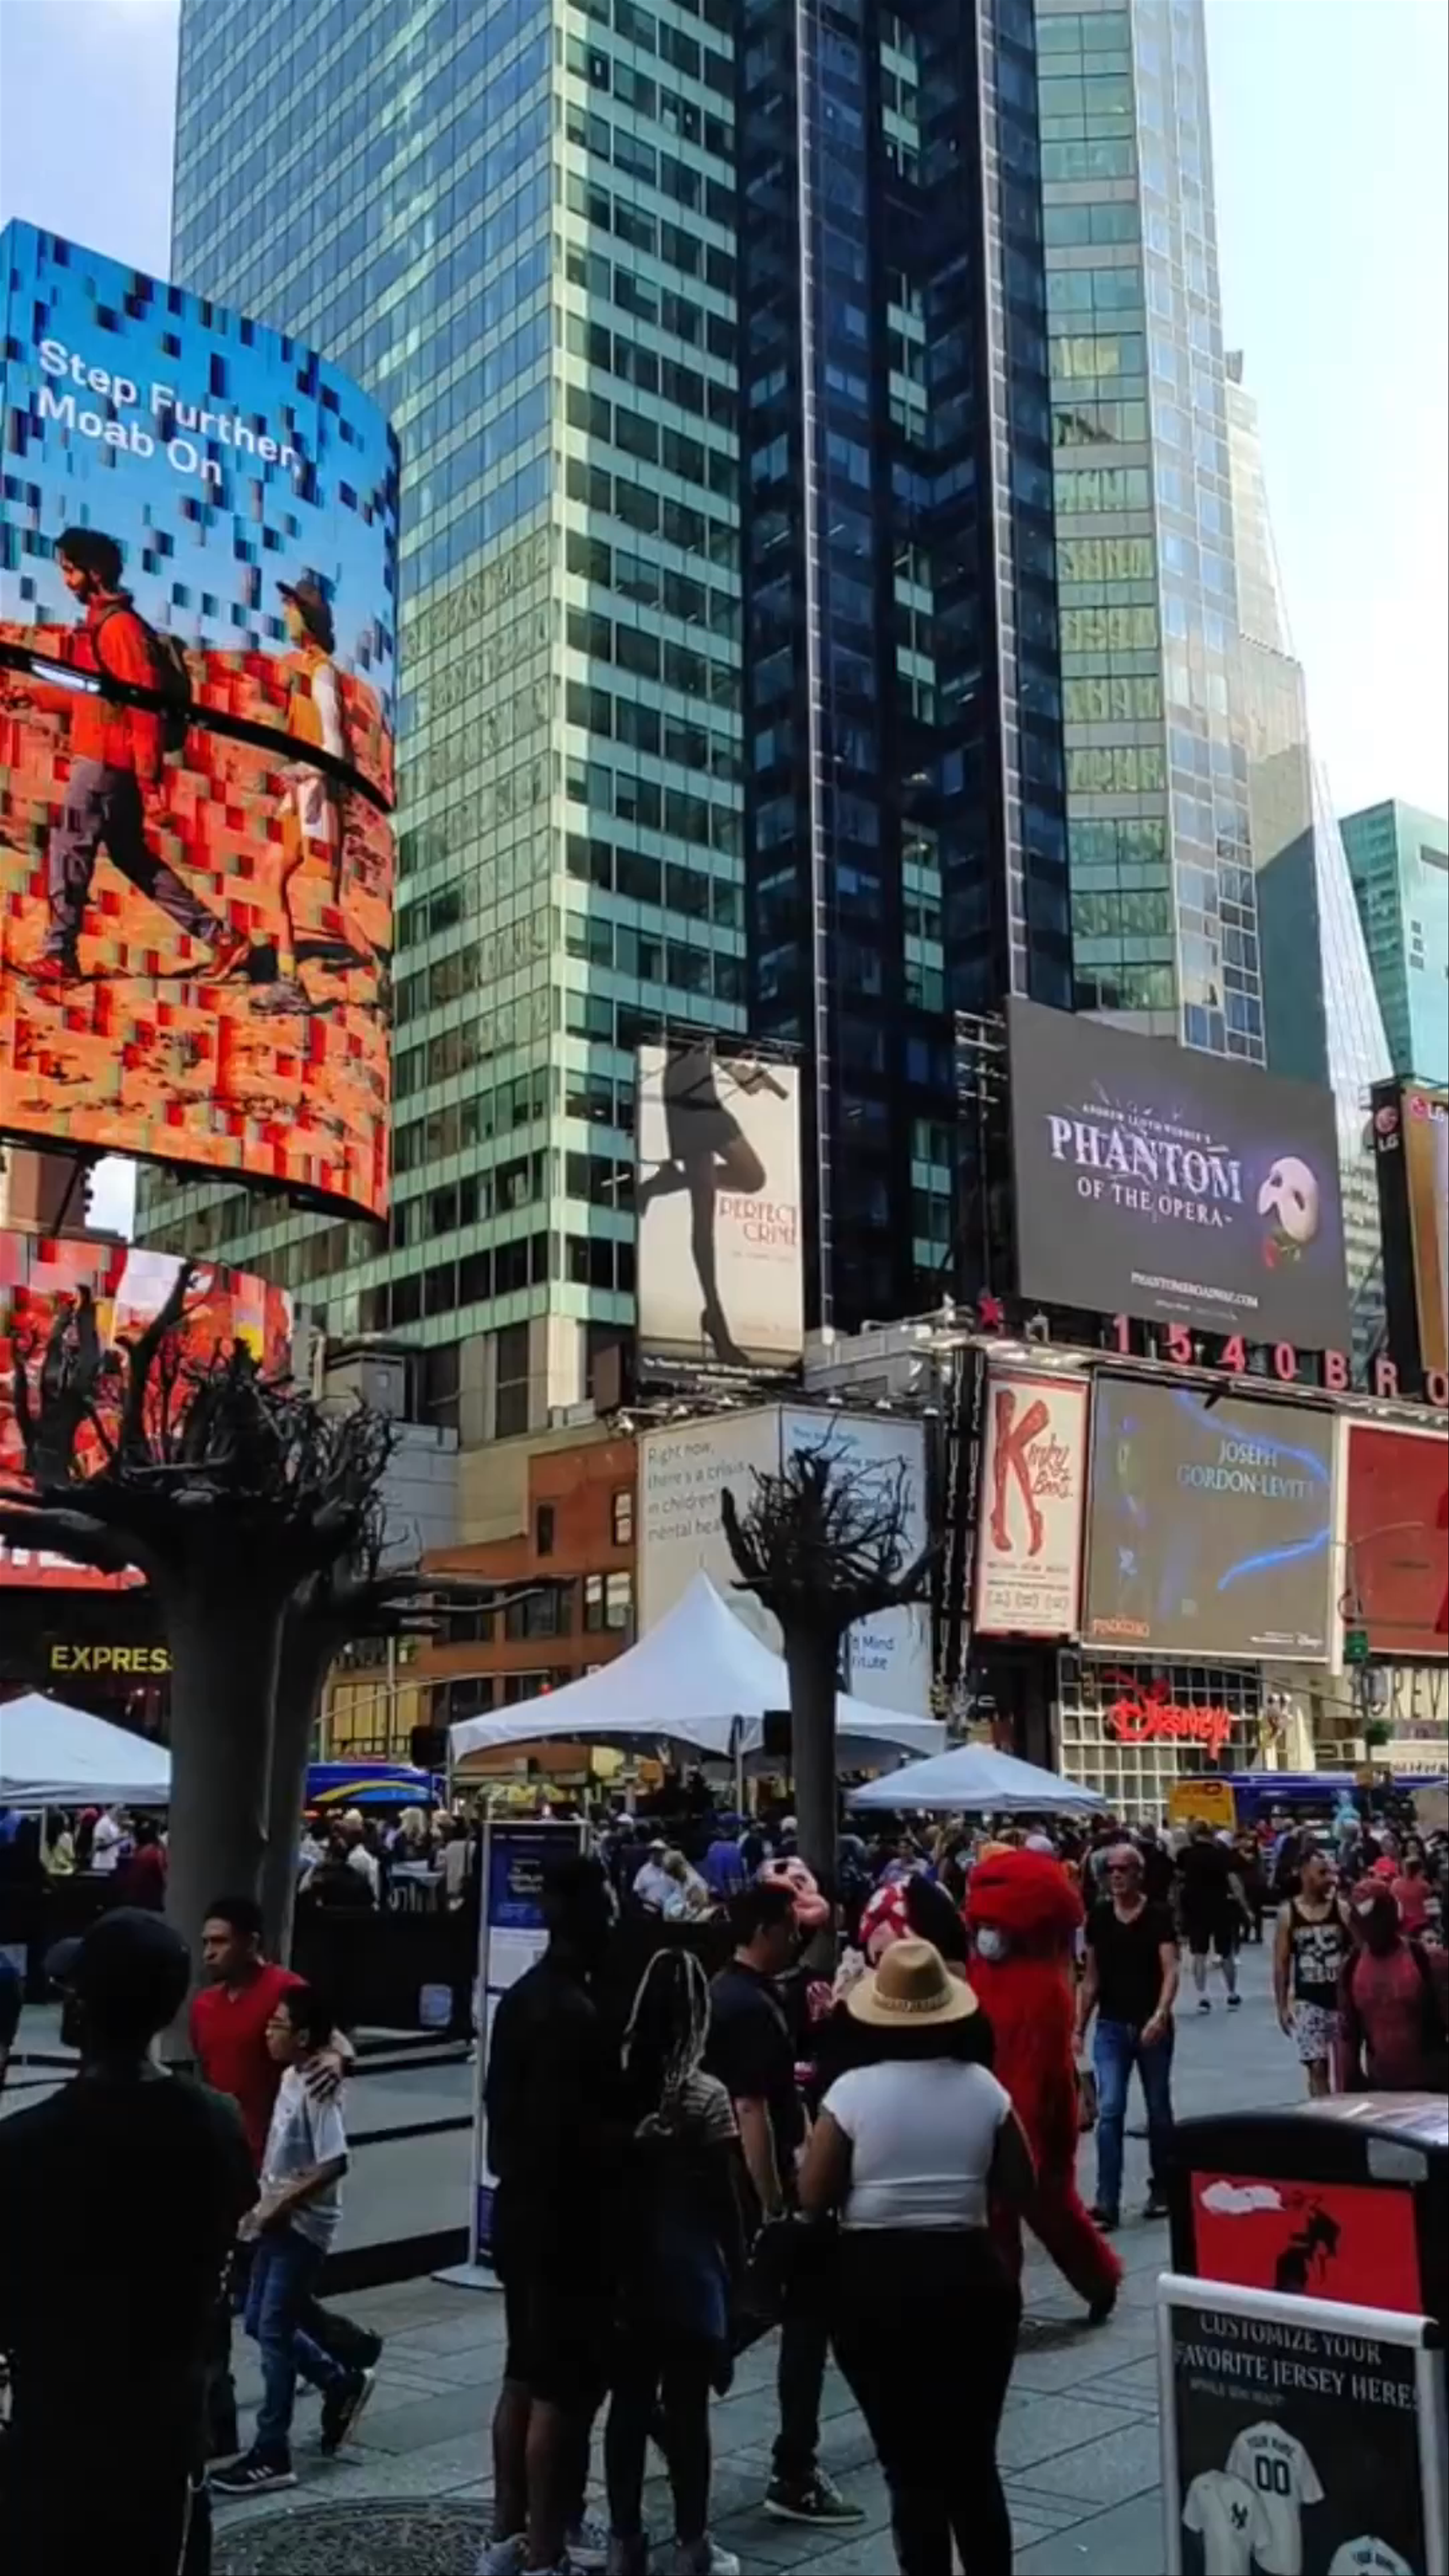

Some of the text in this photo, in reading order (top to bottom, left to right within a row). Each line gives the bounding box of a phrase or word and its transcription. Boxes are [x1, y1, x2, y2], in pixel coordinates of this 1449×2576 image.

[39, 339, 137, 408] Step
[38, 386, 223, 487] Moab On
[1046, 1114, 1244, 1204] PHANTOM
[1378, 1134, 1400, 1152] LG
[1077, 1174, 1224, 1229] OF THE OPERA
[1113, 1312, 1297, 1381] 1540
[1218, 1438, 1278, 1469] JOSEPH
[1176, 1464, 1315, 1500] GORDON-LEVITT
[51, 1644, 174, 1674] EXPRES
[1102, 1670, 1231, 1762] Disney
[1199, 2312, 1382, 2366] CUSTOMIZE YOUR
[1173, 2341, 1269, 2381] FAVORITE
[1272, 2358, 1345, 2396] JERSEY
[1255, 2454, 1291, 2497] 00
